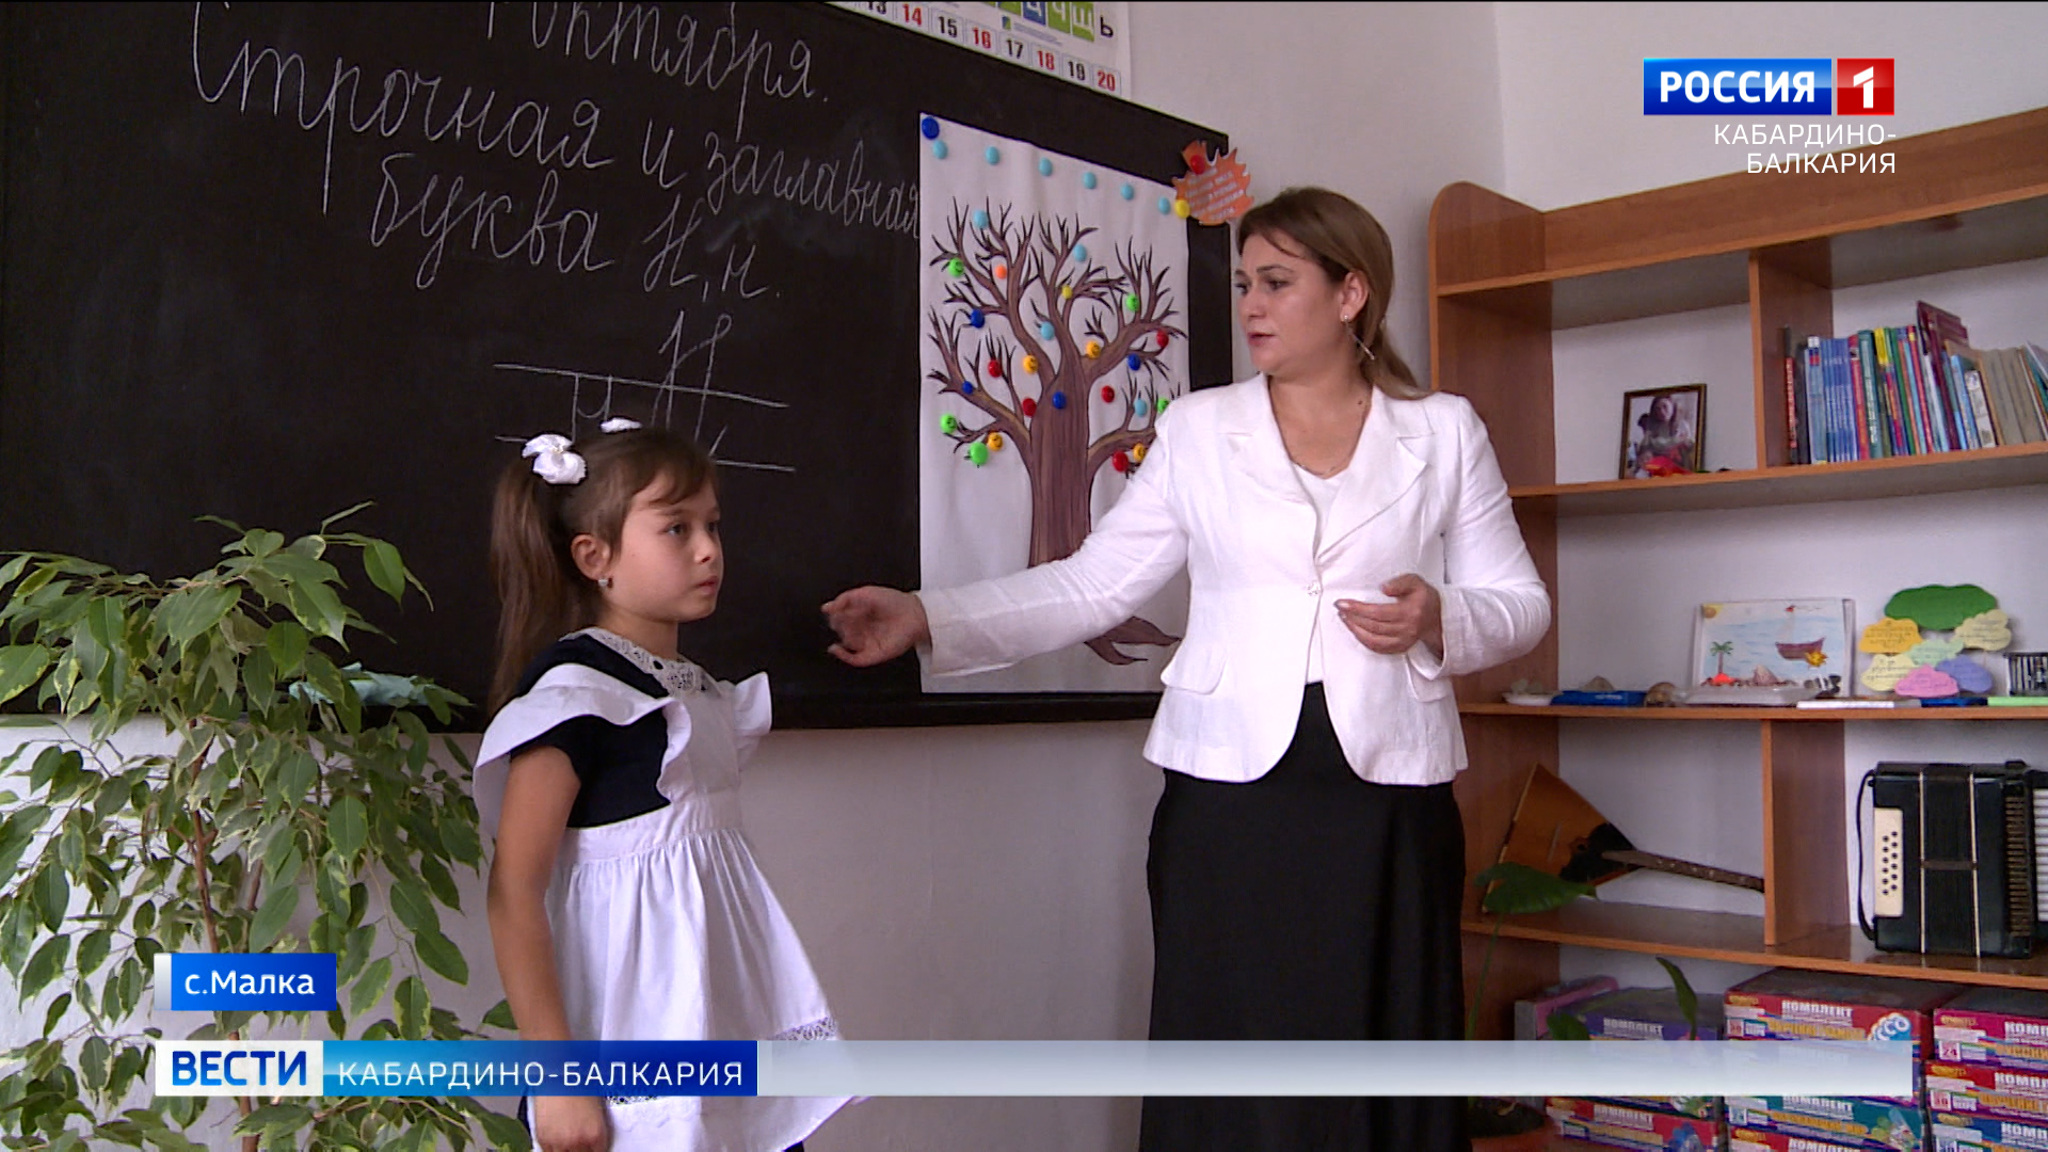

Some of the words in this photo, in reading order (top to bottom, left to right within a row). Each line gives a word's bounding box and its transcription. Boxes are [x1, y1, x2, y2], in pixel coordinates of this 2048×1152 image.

[903, 4, 922, 26] 14
[938, 16, 957, 38] 15
[972, 27, 991, 49] 16
[1006, 39, 1023, 60] 17
[1037, 50, 1055, 71] 18
[1068, 60, 1085, 81] 19
[1097, 69, 1115, 92] 20
[641, 118, 688, 189] и
[371, 152, 616, 290] буква
